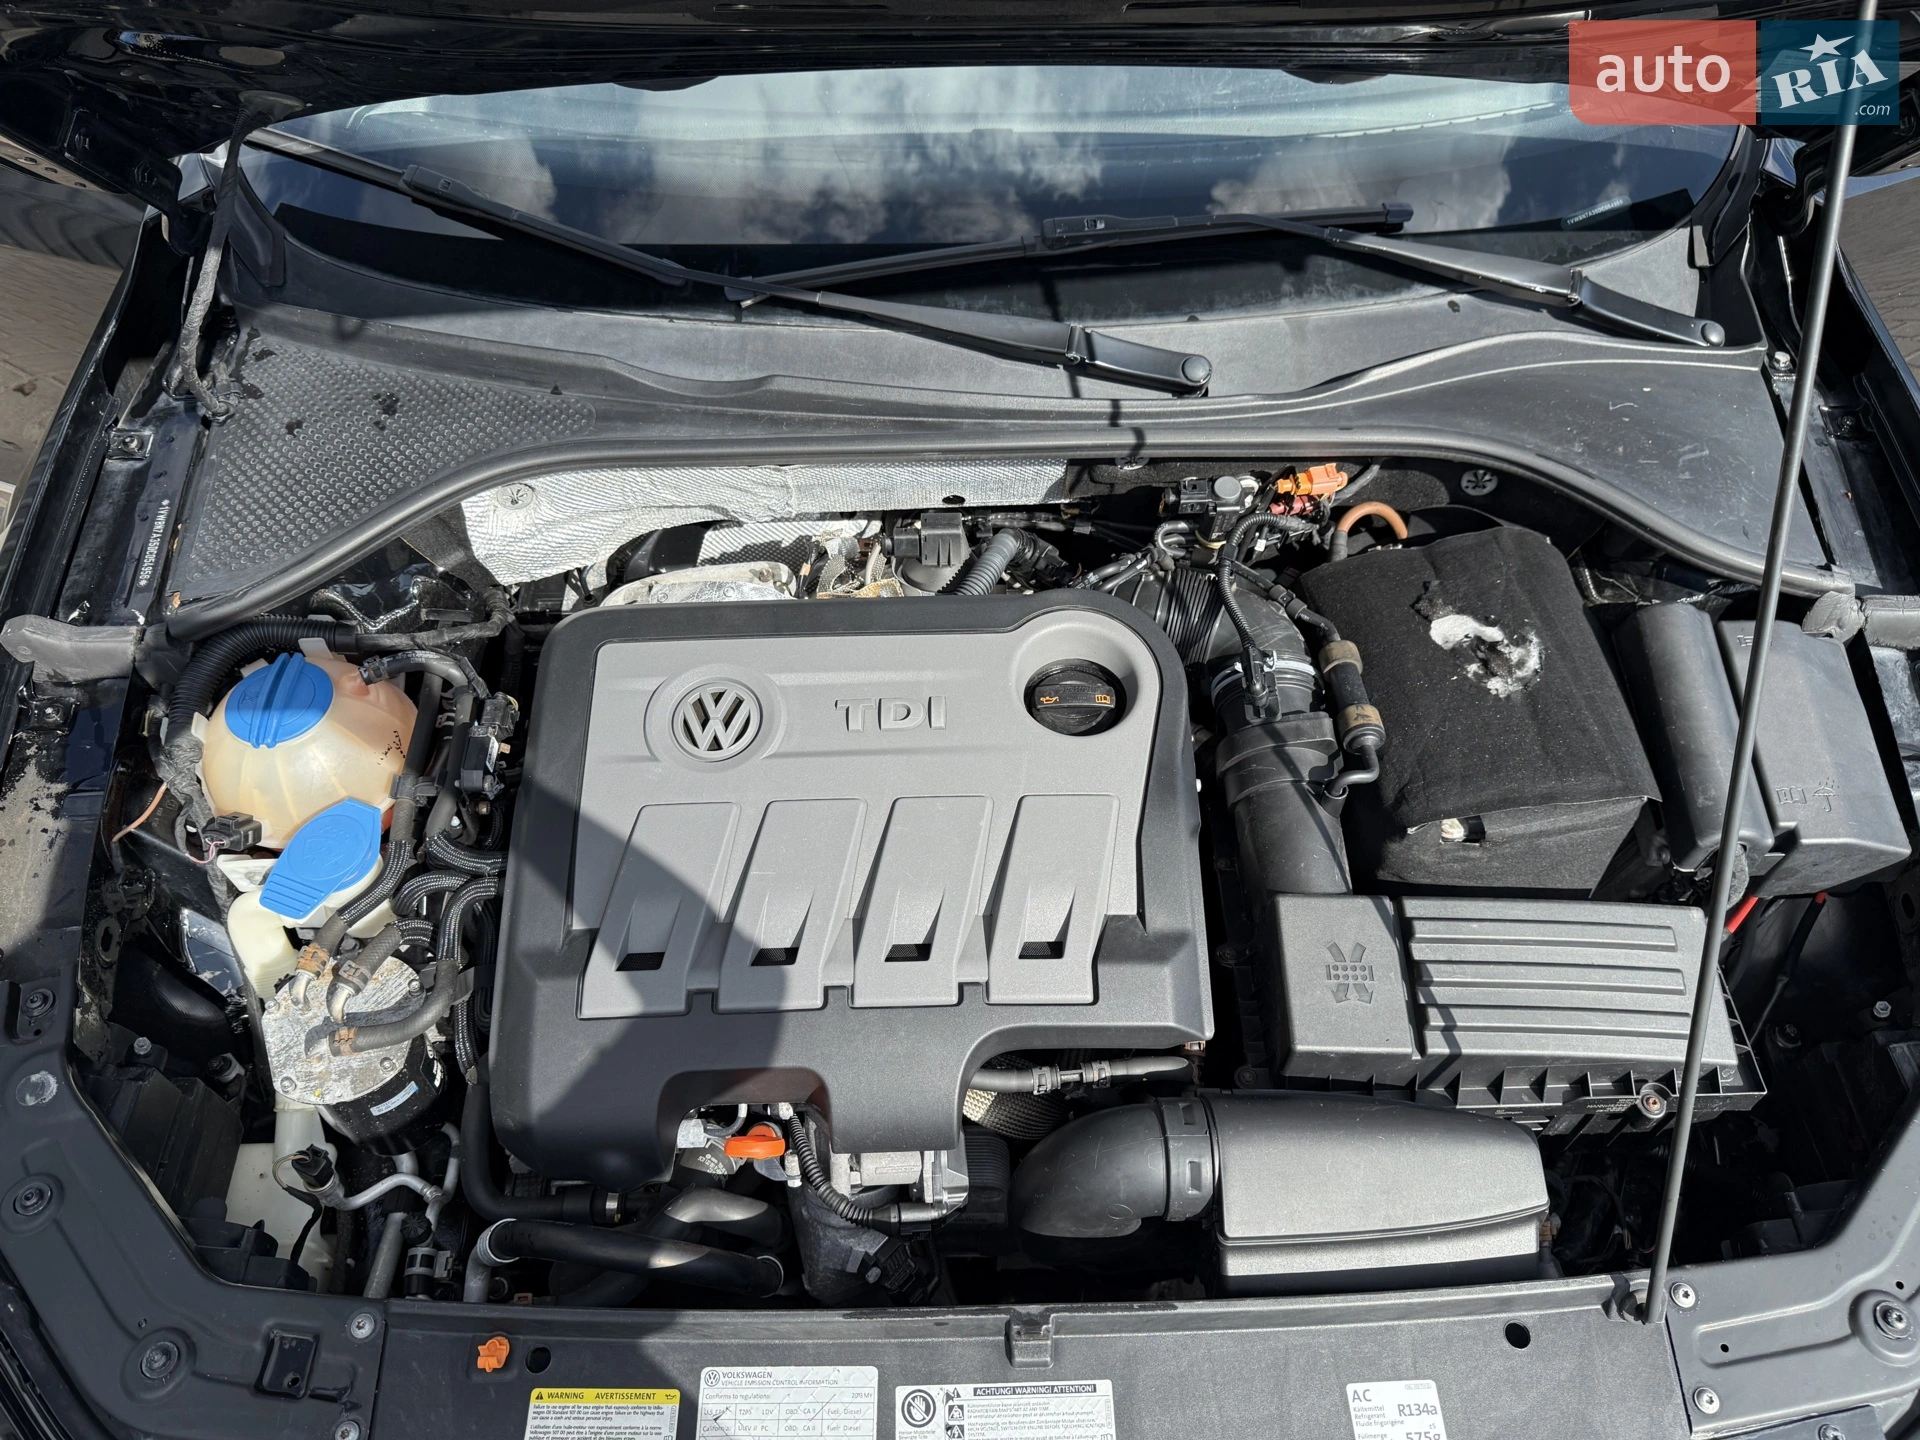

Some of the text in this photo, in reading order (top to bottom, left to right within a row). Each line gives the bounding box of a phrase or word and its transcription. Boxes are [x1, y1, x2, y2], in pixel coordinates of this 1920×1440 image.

[834, 695, 947, 732] TDI
[722, 1371, 773, 1379] VOLKSWAGEN
[548, 1392, 656, 1400] WARNING AVERTISSEMENT
[976, 1385, 1094, 1396] ACHTUNG! WARNING! ATTENTION!
[1352, 1388, 1372, 1402] AC
[1397, 1402, 1438, 1417] R134a
[1354, 1412, 1386, 1420] Refrigerant
